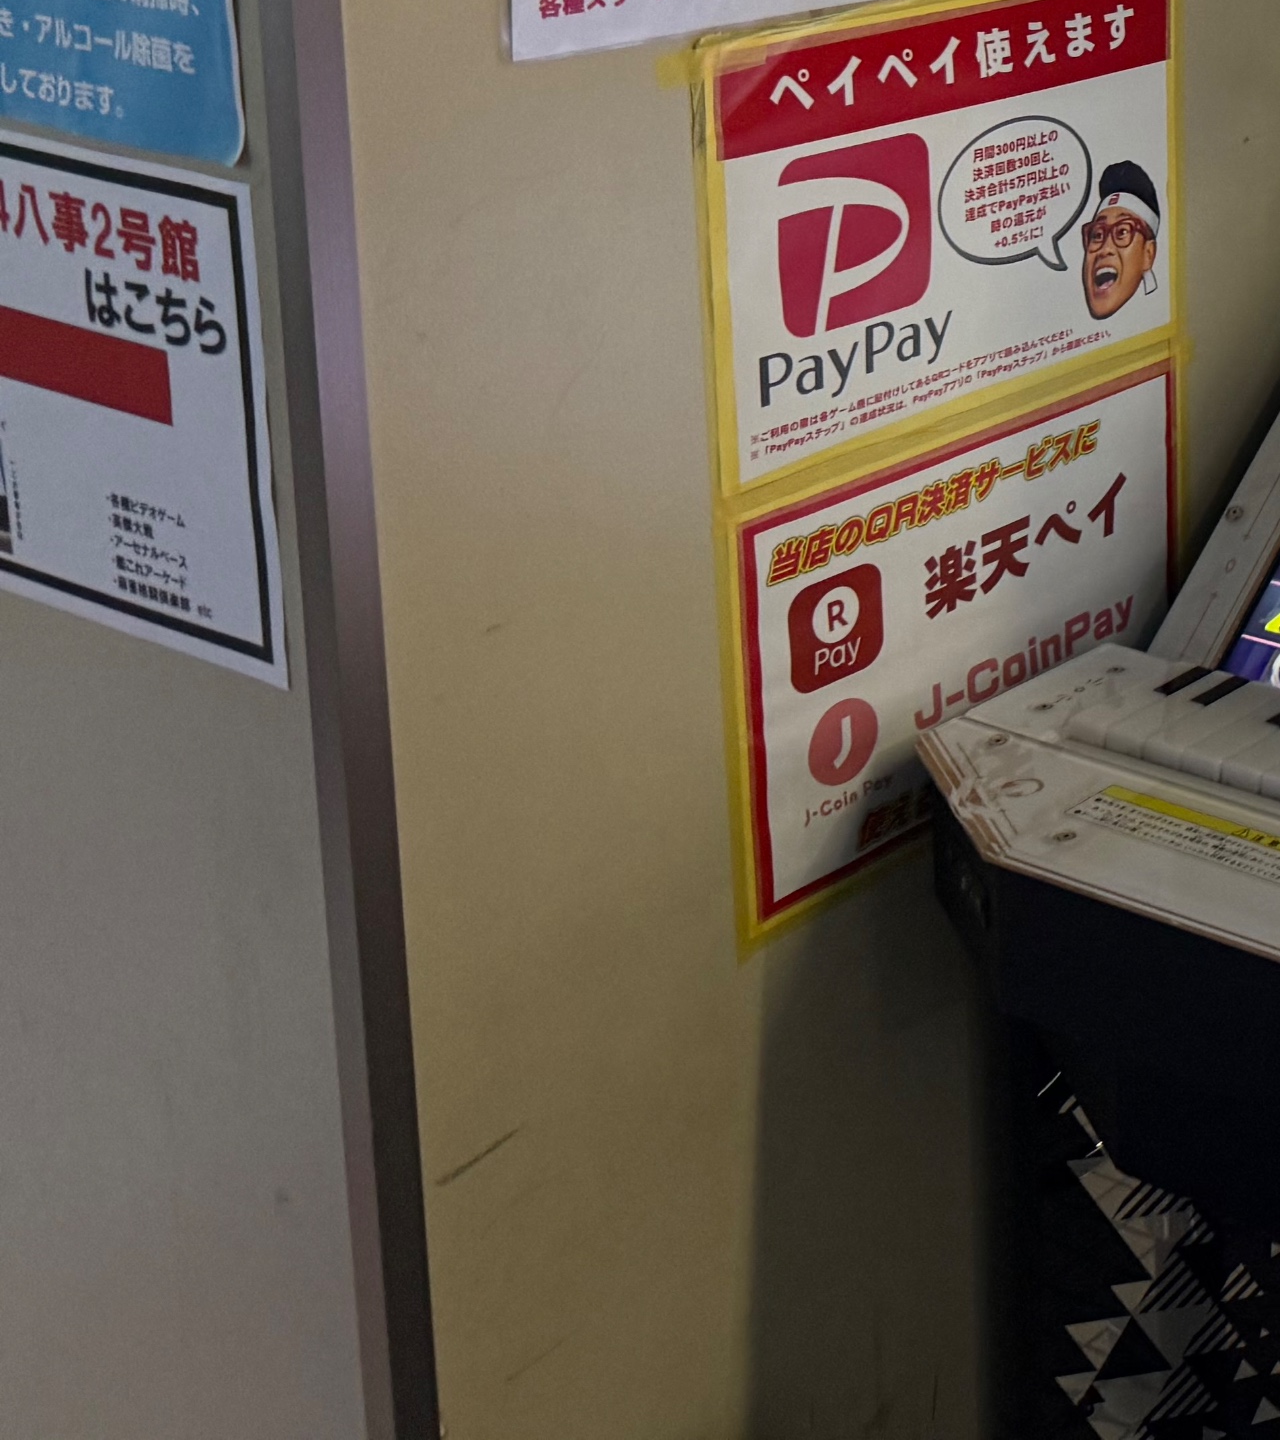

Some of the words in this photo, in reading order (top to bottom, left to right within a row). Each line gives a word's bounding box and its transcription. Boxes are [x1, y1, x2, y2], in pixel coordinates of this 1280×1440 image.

[768, 3, 1135, 110] ペイペイ使えます
[964, 163, 1070, 203] 決済合計5万円以上の
[973, 129, 1059, 163] 月間300円以上の
[964, 182, 1071, 223] 達成でPayPay支払い
[84, 267, 227, 355] はこちら
[758, 309, 953, 408] PayPay
[766, 419, 1102, 587] 当店のQR決済サービスに
[924, 471, 1128, 620] 楽天ペイ
[814, 635, 862, 675] Pay
[914, 593, 1135, 730] J-CoinPay
[803, 789, 859, 827] J-Coin
